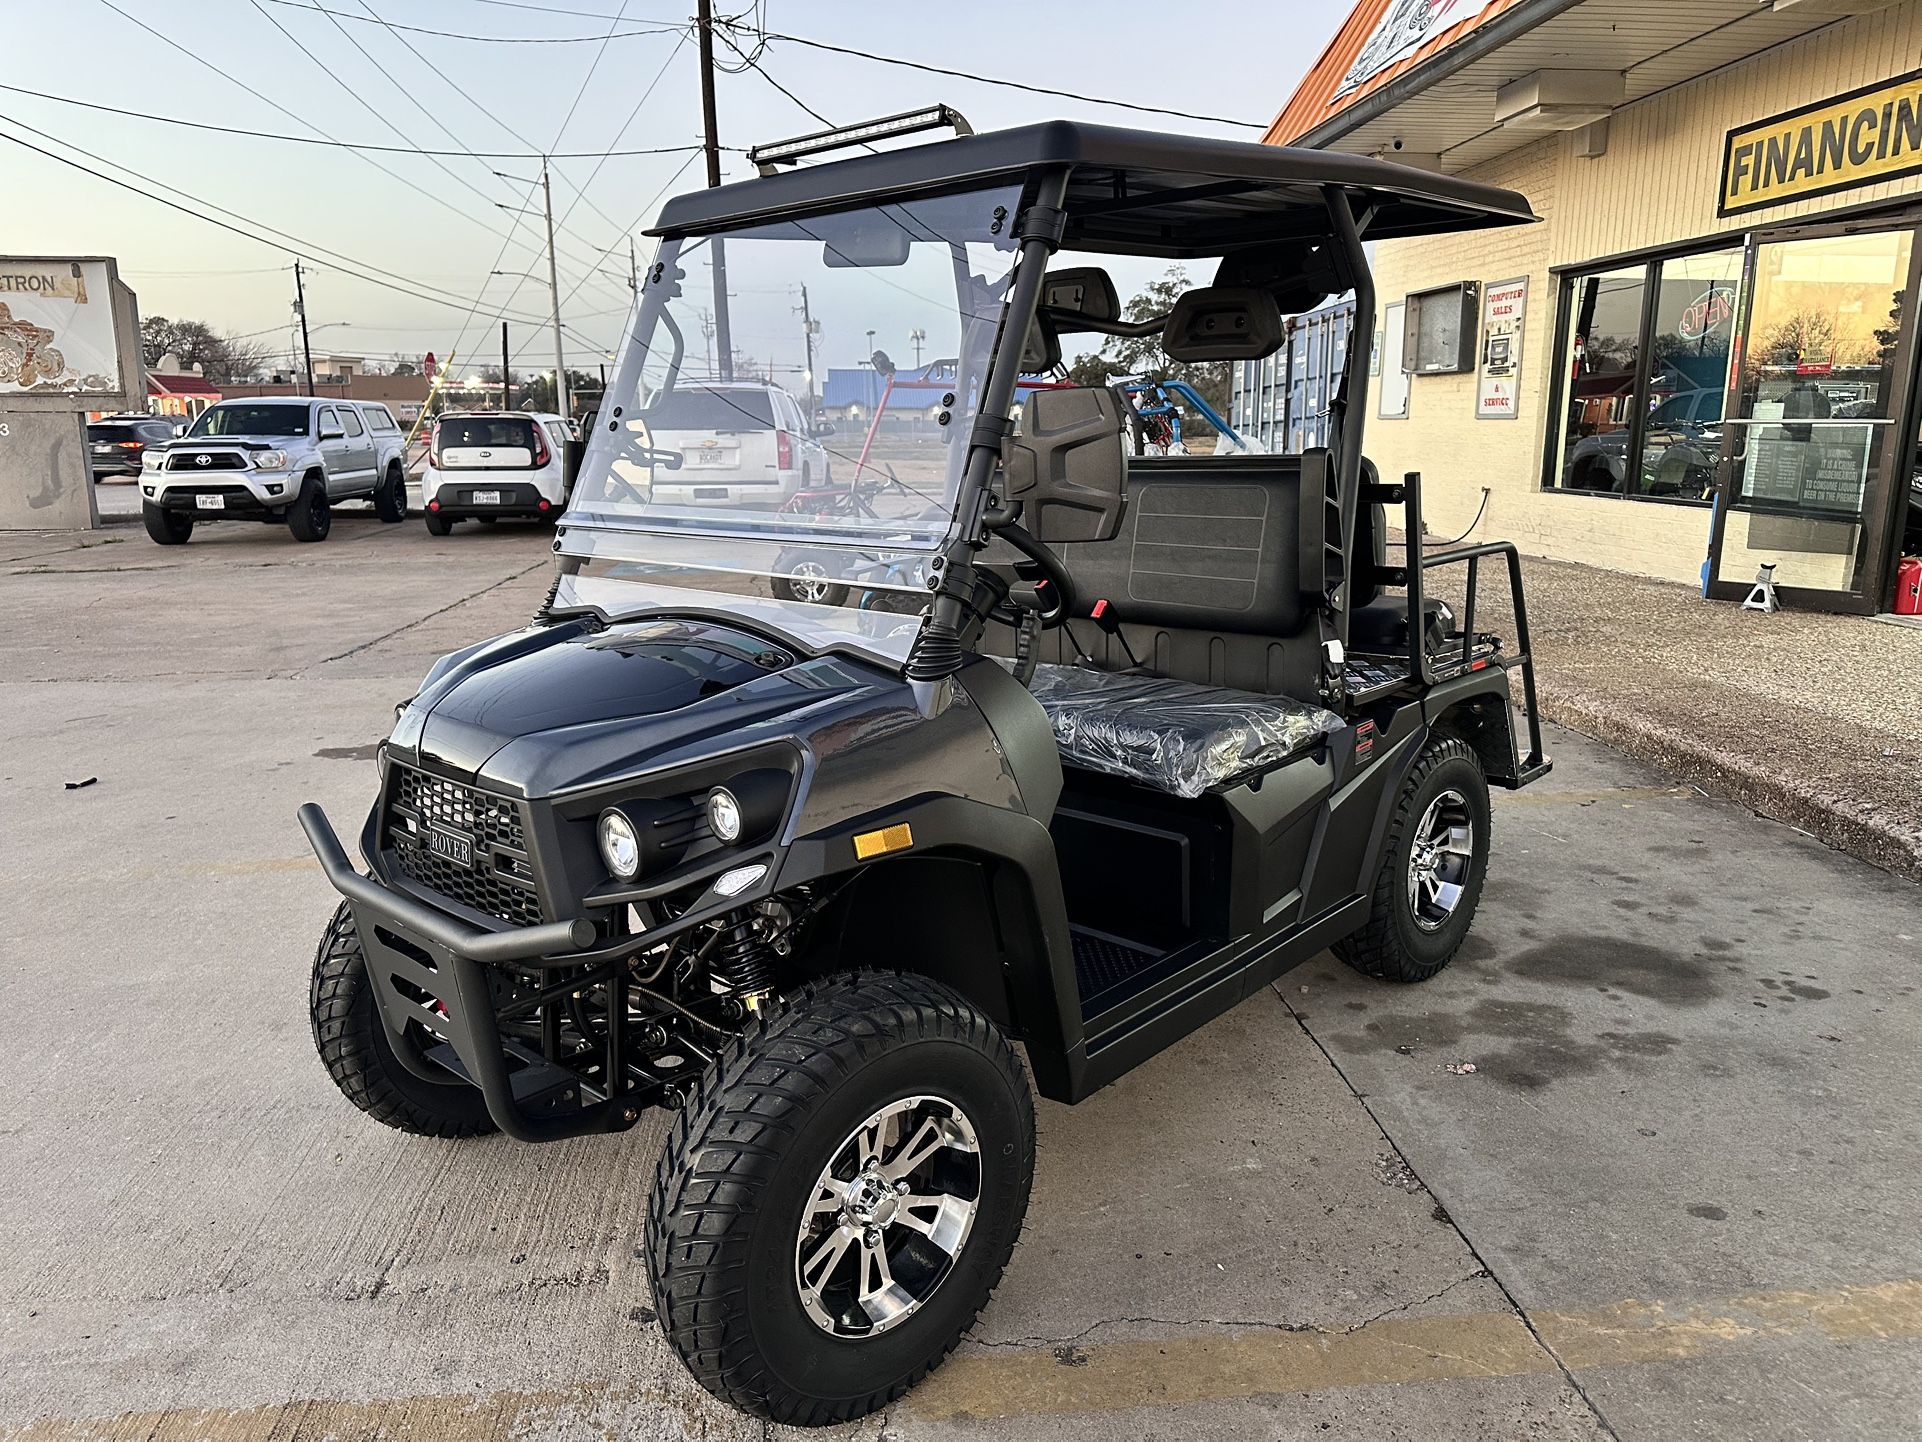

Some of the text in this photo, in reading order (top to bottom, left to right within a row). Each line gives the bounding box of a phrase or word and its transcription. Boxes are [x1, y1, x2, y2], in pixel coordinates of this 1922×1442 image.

[1730, 93, 1922, 197] FINANCIN
[0, 275, 55, 291] TRON
[1488, 289, 1524, 303] COMPUTER
[1492, 304, 1513, 316] SALES
[1682, 292, 1730, 332] OPEN
[1484, 397, 1510, 407] SERVICE
[432, 831, 469, 863] ROVER
